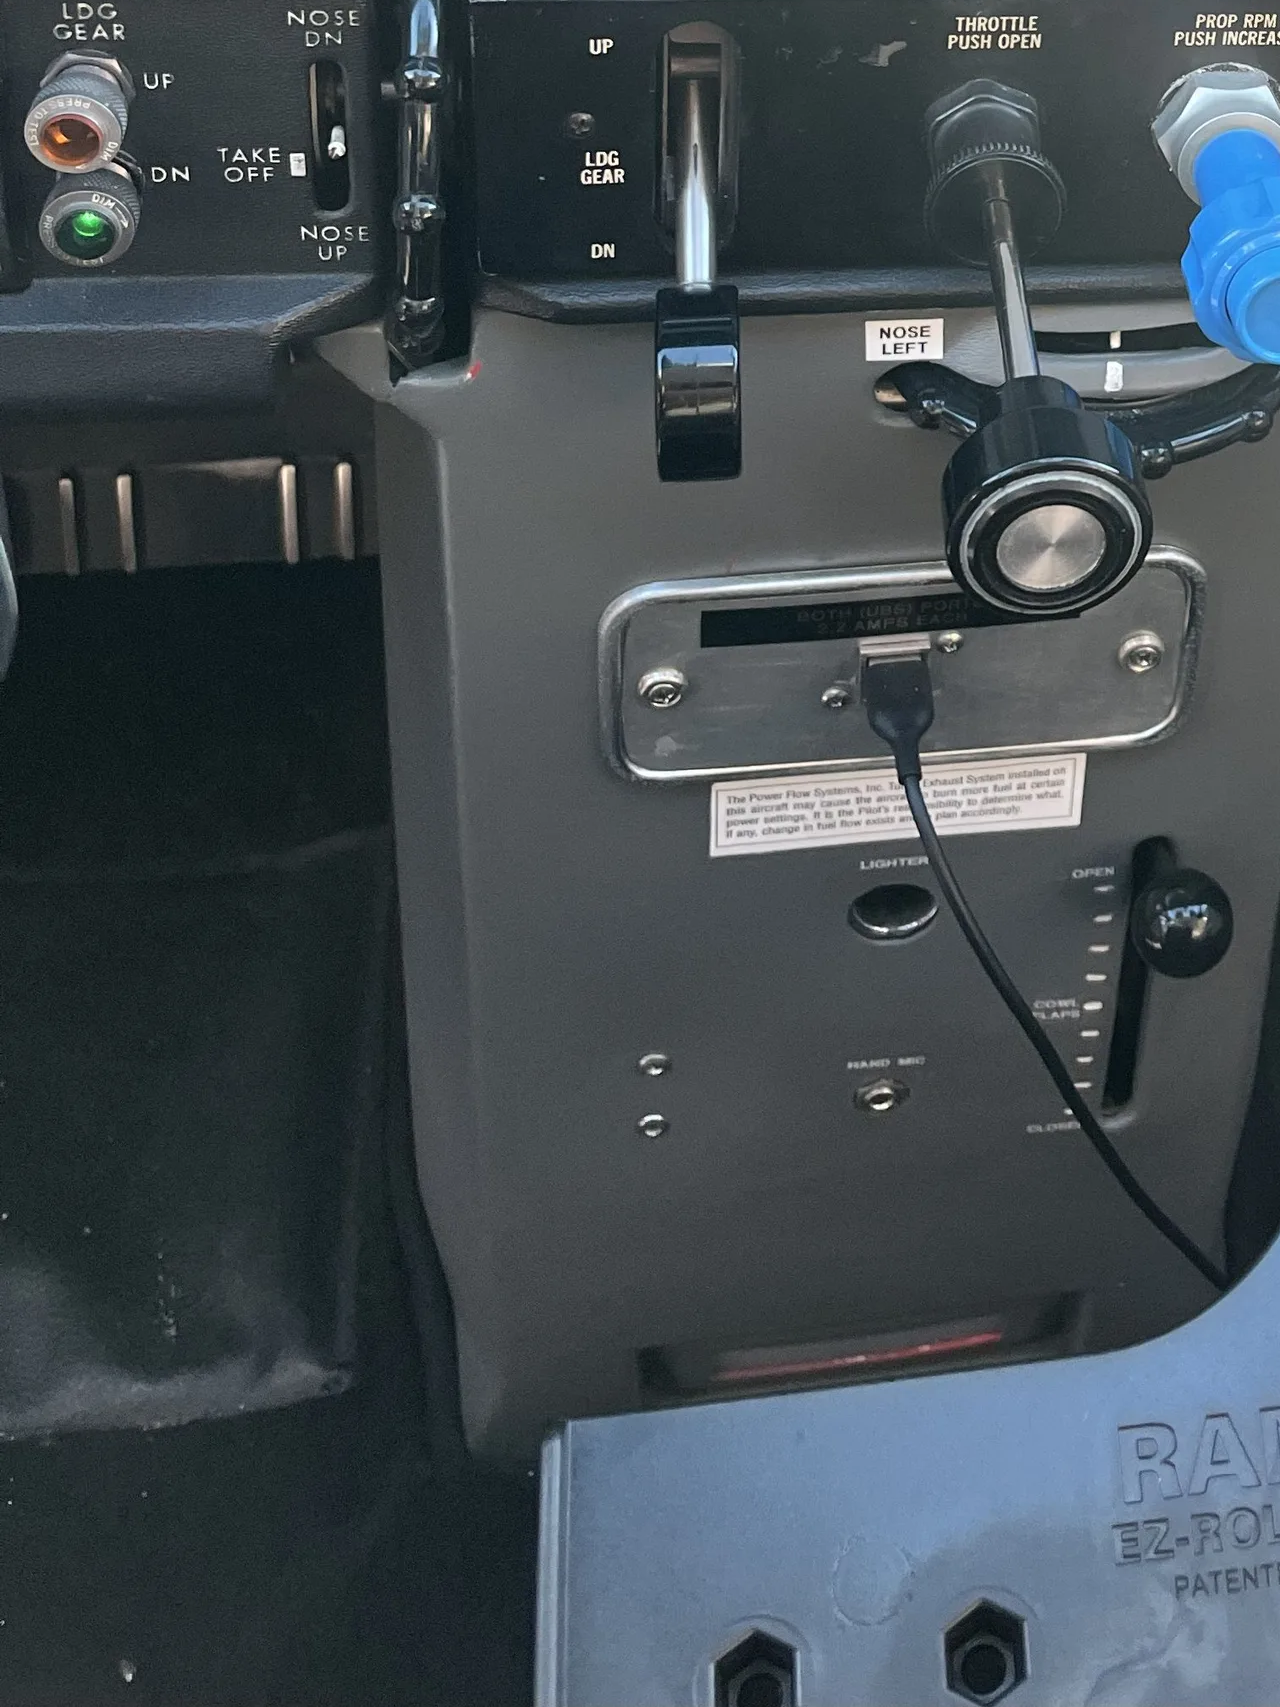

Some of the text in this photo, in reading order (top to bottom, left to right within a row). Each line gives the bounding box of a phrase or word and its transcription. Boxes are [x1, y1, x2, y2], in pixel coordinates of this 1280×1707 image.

[62, 3, 117, 20] LDG
[287, 10, 360, 27] NOSE
[955, 16, 1039, 32] THROTTLE
[1195, 14, 1278, 29] PROP RPM
[52, 24, 125, 42] GEAR
[1174, 31, 1217, 46] PUSH
[947, 34, 1042, 49] PUSH OPEN
[101, 141, 118, 162] DIM
[217, 147, 281, 164] TAKE
[585, 151, 620, 167] LDG
[224, 167, 274, 183] OFF
[580, 167, 625, 185] GEAR
[91, 193, 115, 209] DIM
[301, 226, 370, 242] NOSE
[878, 326, 931, 340] NOSE
[882, 341, 927, 356] LEFT
[727, 794, 746, 806] The
[749, 791, 782, 804] Power
[786, 788, 811, 799] Flow
[923, 774, 964, 788] Exhaust
[966, 771, 1006, 786] System
[1008, 767, 1049, 780] installed
[859, 856, 931, 870] LIGHTER
[1071, 866, 1115, 879] OPEN
